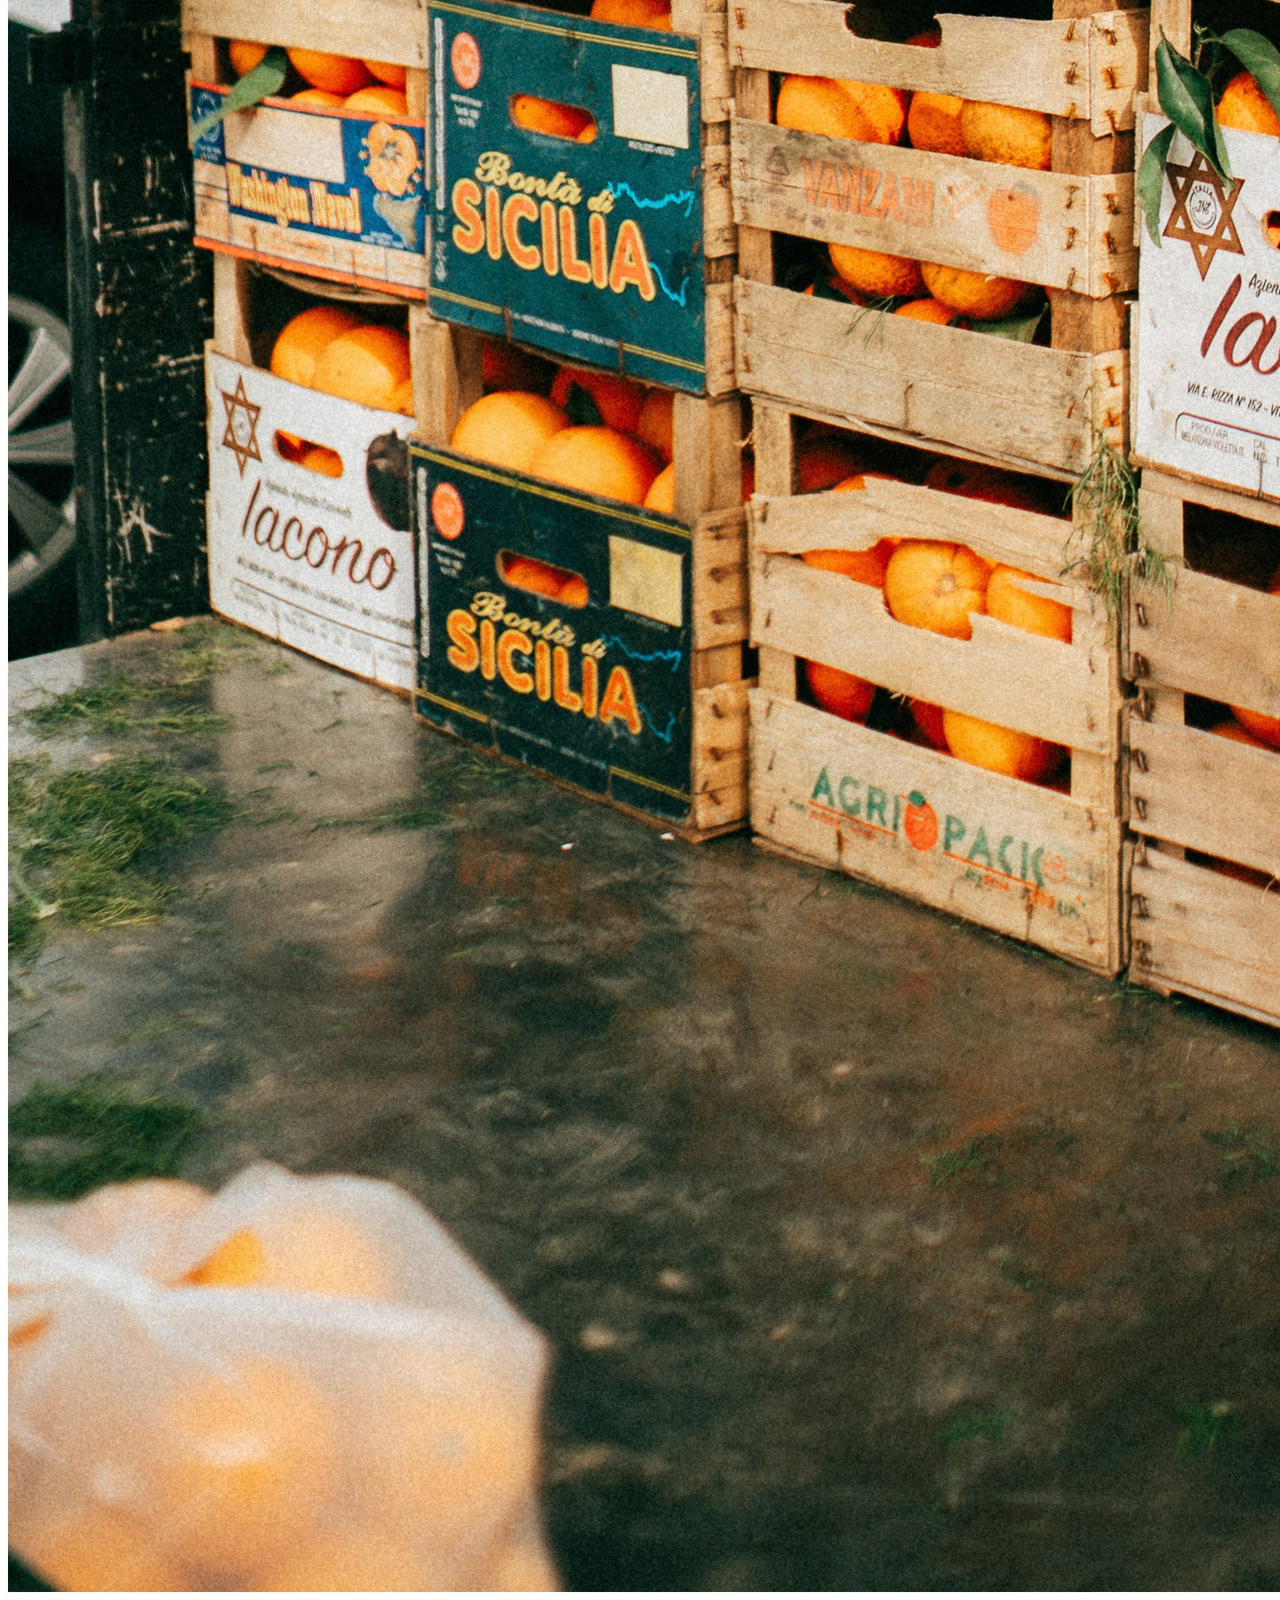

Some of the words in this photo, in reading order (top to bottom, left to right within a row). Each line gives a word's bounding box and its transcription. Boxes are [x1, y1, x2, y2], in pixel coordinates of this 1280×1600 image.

[473, 150, 584, 206] Bontà
[451, 177, 657, 302] SICILIA
[1186, 381, 1201, 395] VIA
[1210, 388, 1234, 405] RIZZA
[1247, 398, 1263, 412] 152
[241, 478, 397, 590] Iacono
[468, 590, 578, 649] Bontà
[445, 607, 644, 736] SICILIA
